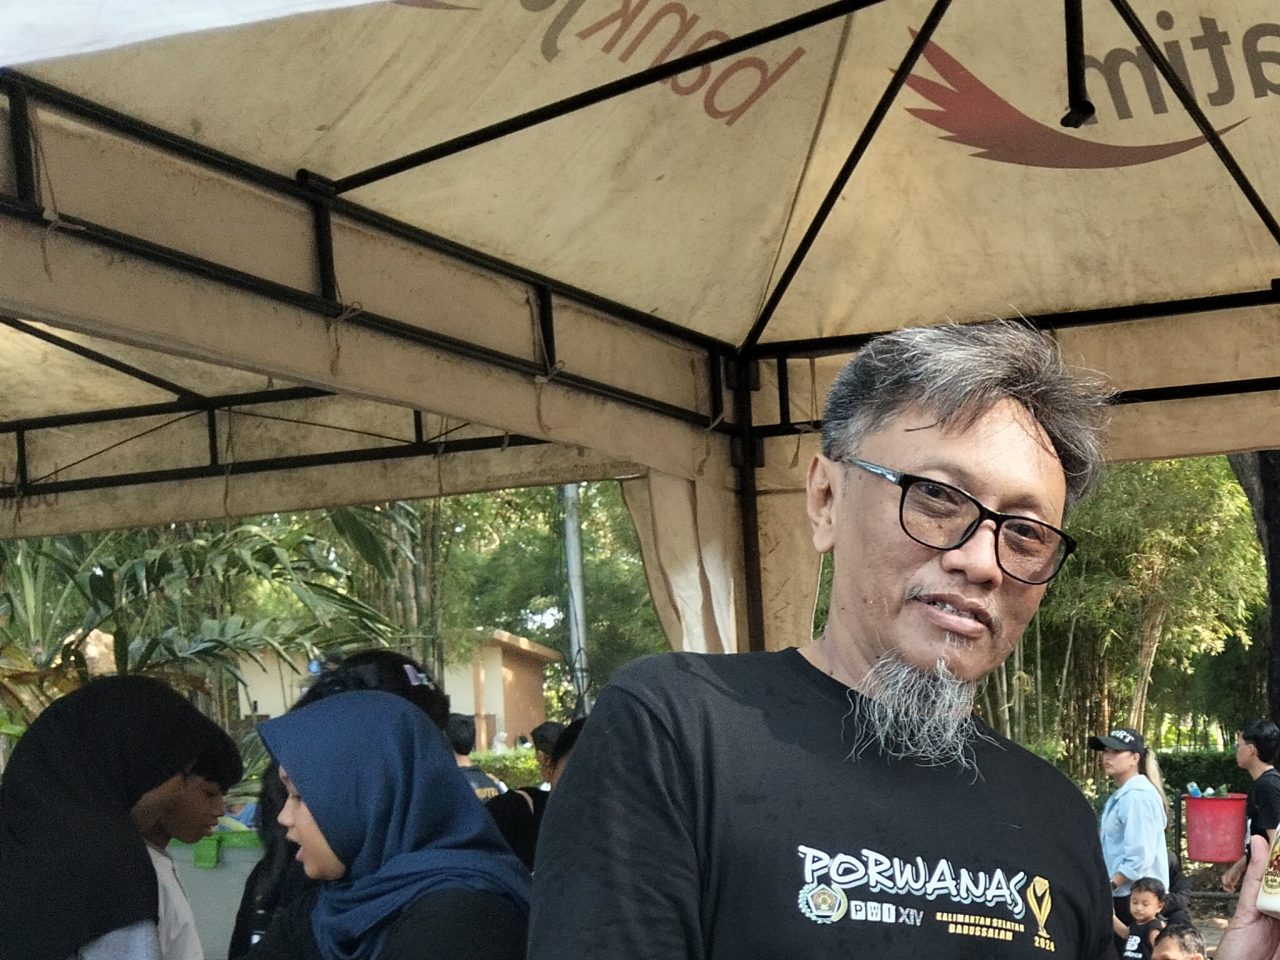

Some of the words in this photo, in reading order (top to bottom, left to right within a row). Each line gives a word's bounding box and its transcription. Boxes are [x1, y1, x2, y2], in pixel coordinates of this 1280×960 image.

[798, 845, 1027, 919] PORWANAS
[851, 900, 896, 923] PWI
[898, 907, 925, 926] XIV
[936, 911, 991, 926] KALIMANTAN
[991, 917, 1025, 932] SELATAN
[1034, 935, 1056, 952] 2024
